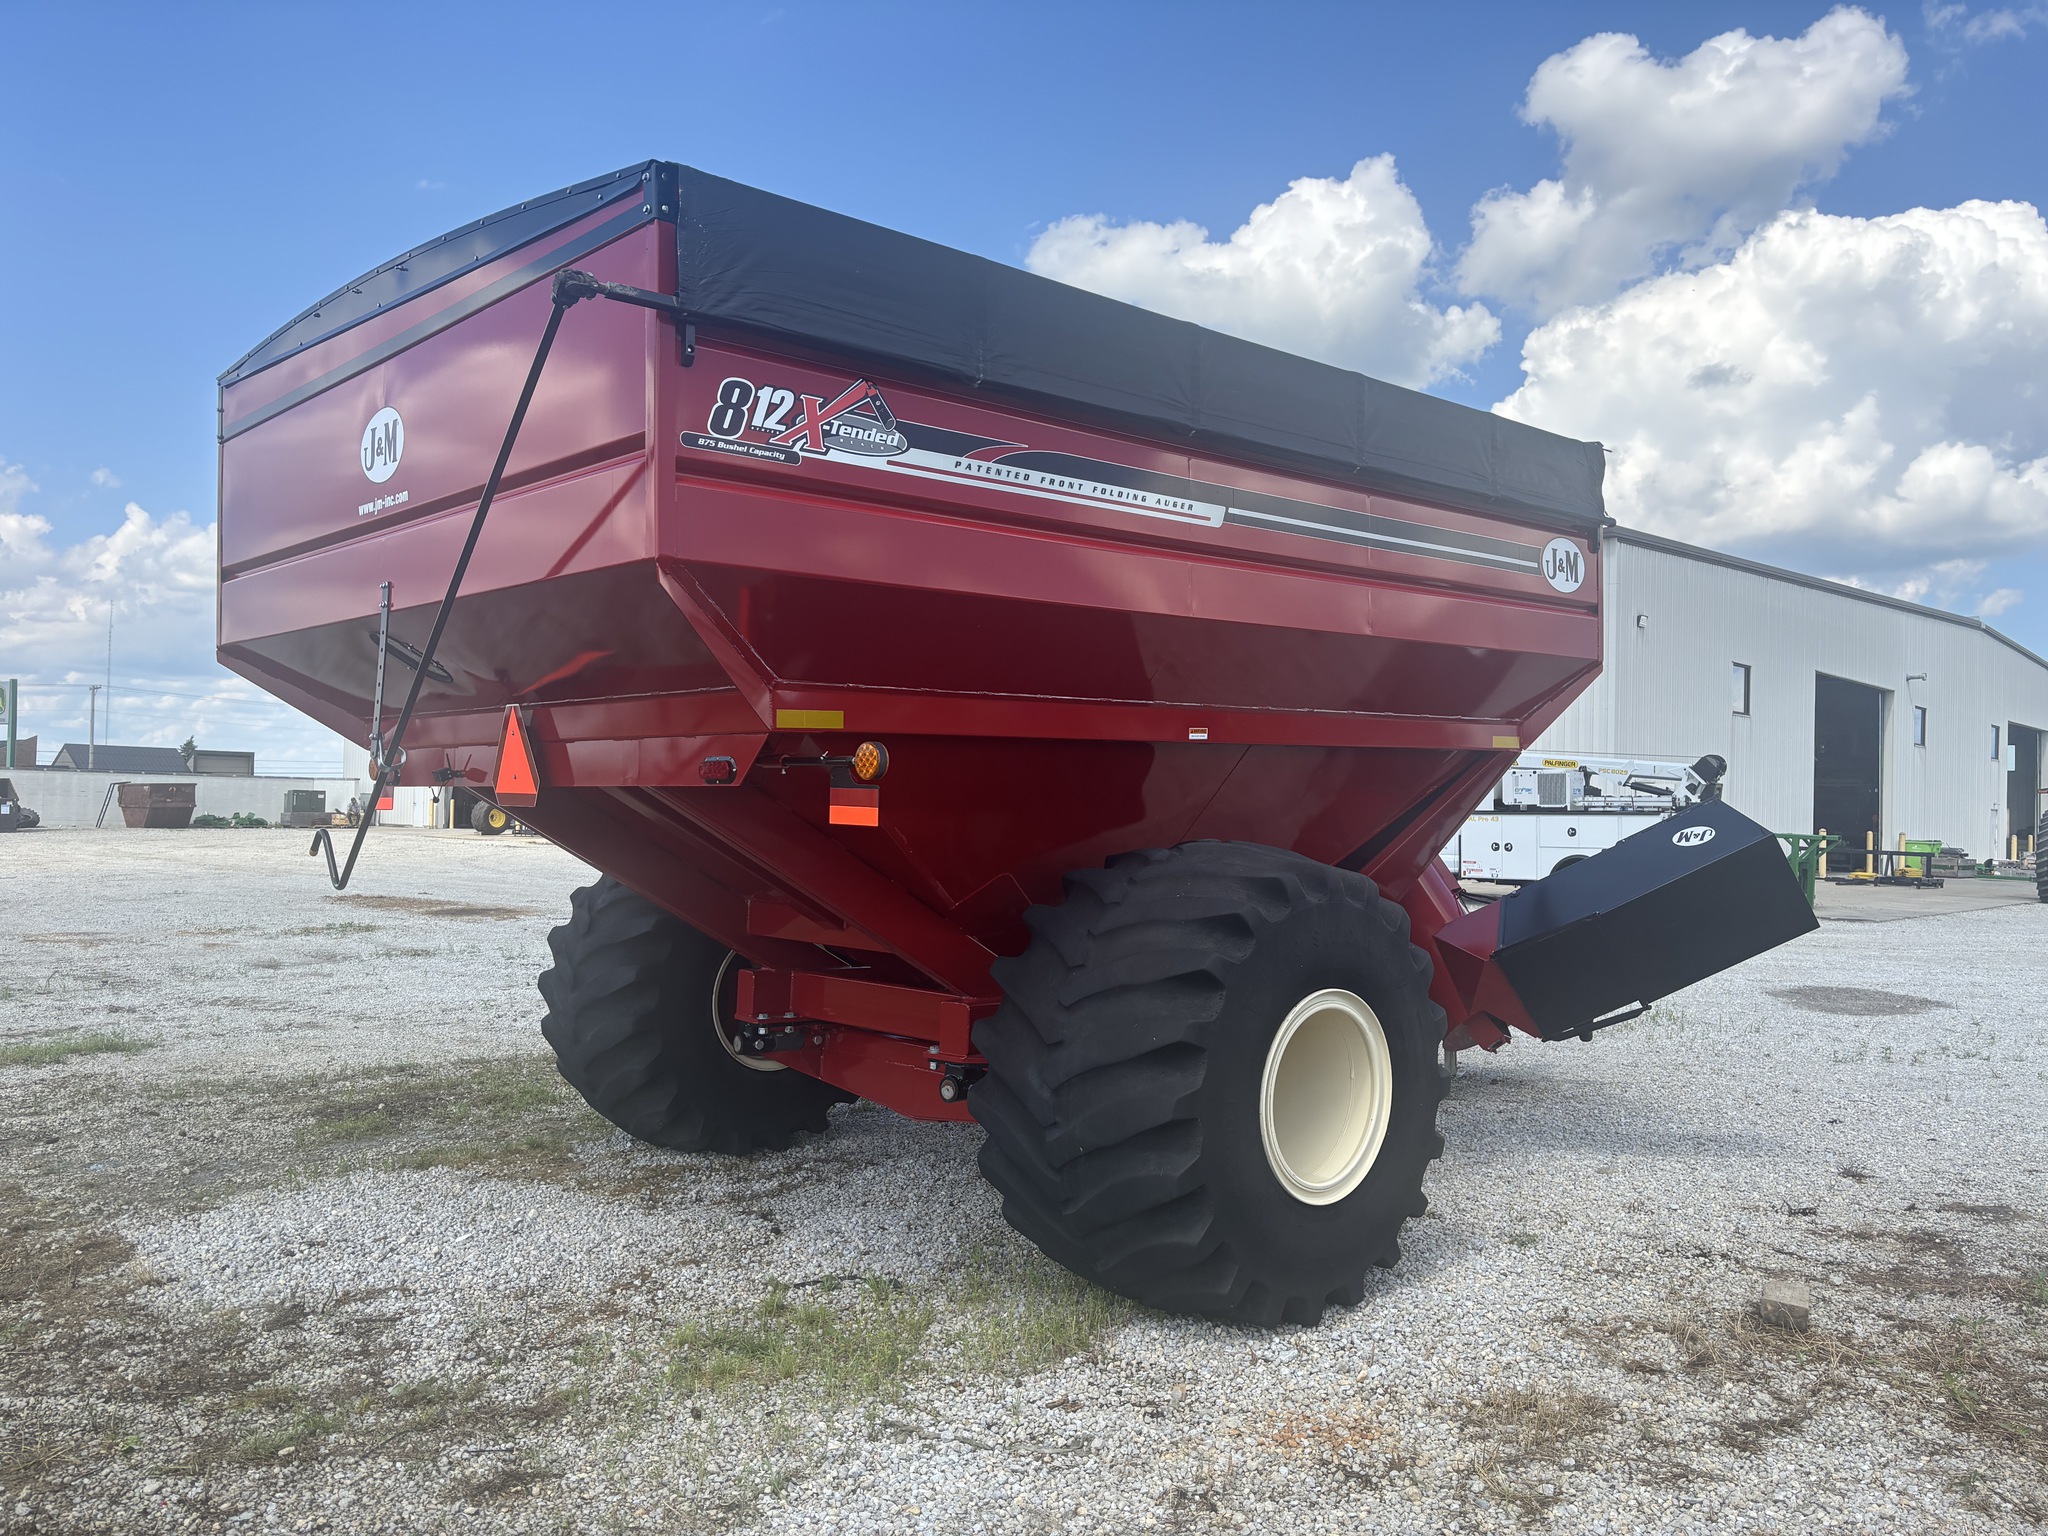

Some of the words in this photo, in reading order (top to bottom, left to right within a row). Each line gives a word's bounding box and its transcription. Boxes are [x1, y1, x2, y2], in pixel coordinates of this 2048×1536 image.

[707, 376, 795, 440] 812
[363, 418, 399, 472] J&M
[697, 437, 716, 448] 875
[717, 441, 748, 453] Bushel
[749, 446, 786, 461] Capacity
[954, 460, 1031, 482] PATENTED
[1040, 476, 1084, 492] FRONT
[1092, 485, 1148, 503] FOLDING
[1155, 497, 1195, 512] AUGER
[358, 490, 409, 516] www.jm-inc.com
[1545, 547, 1580, 584] J&M
[1543, 759, 1577, 768] PALFINGER
[1675, 828, 1714, 844] J&M
